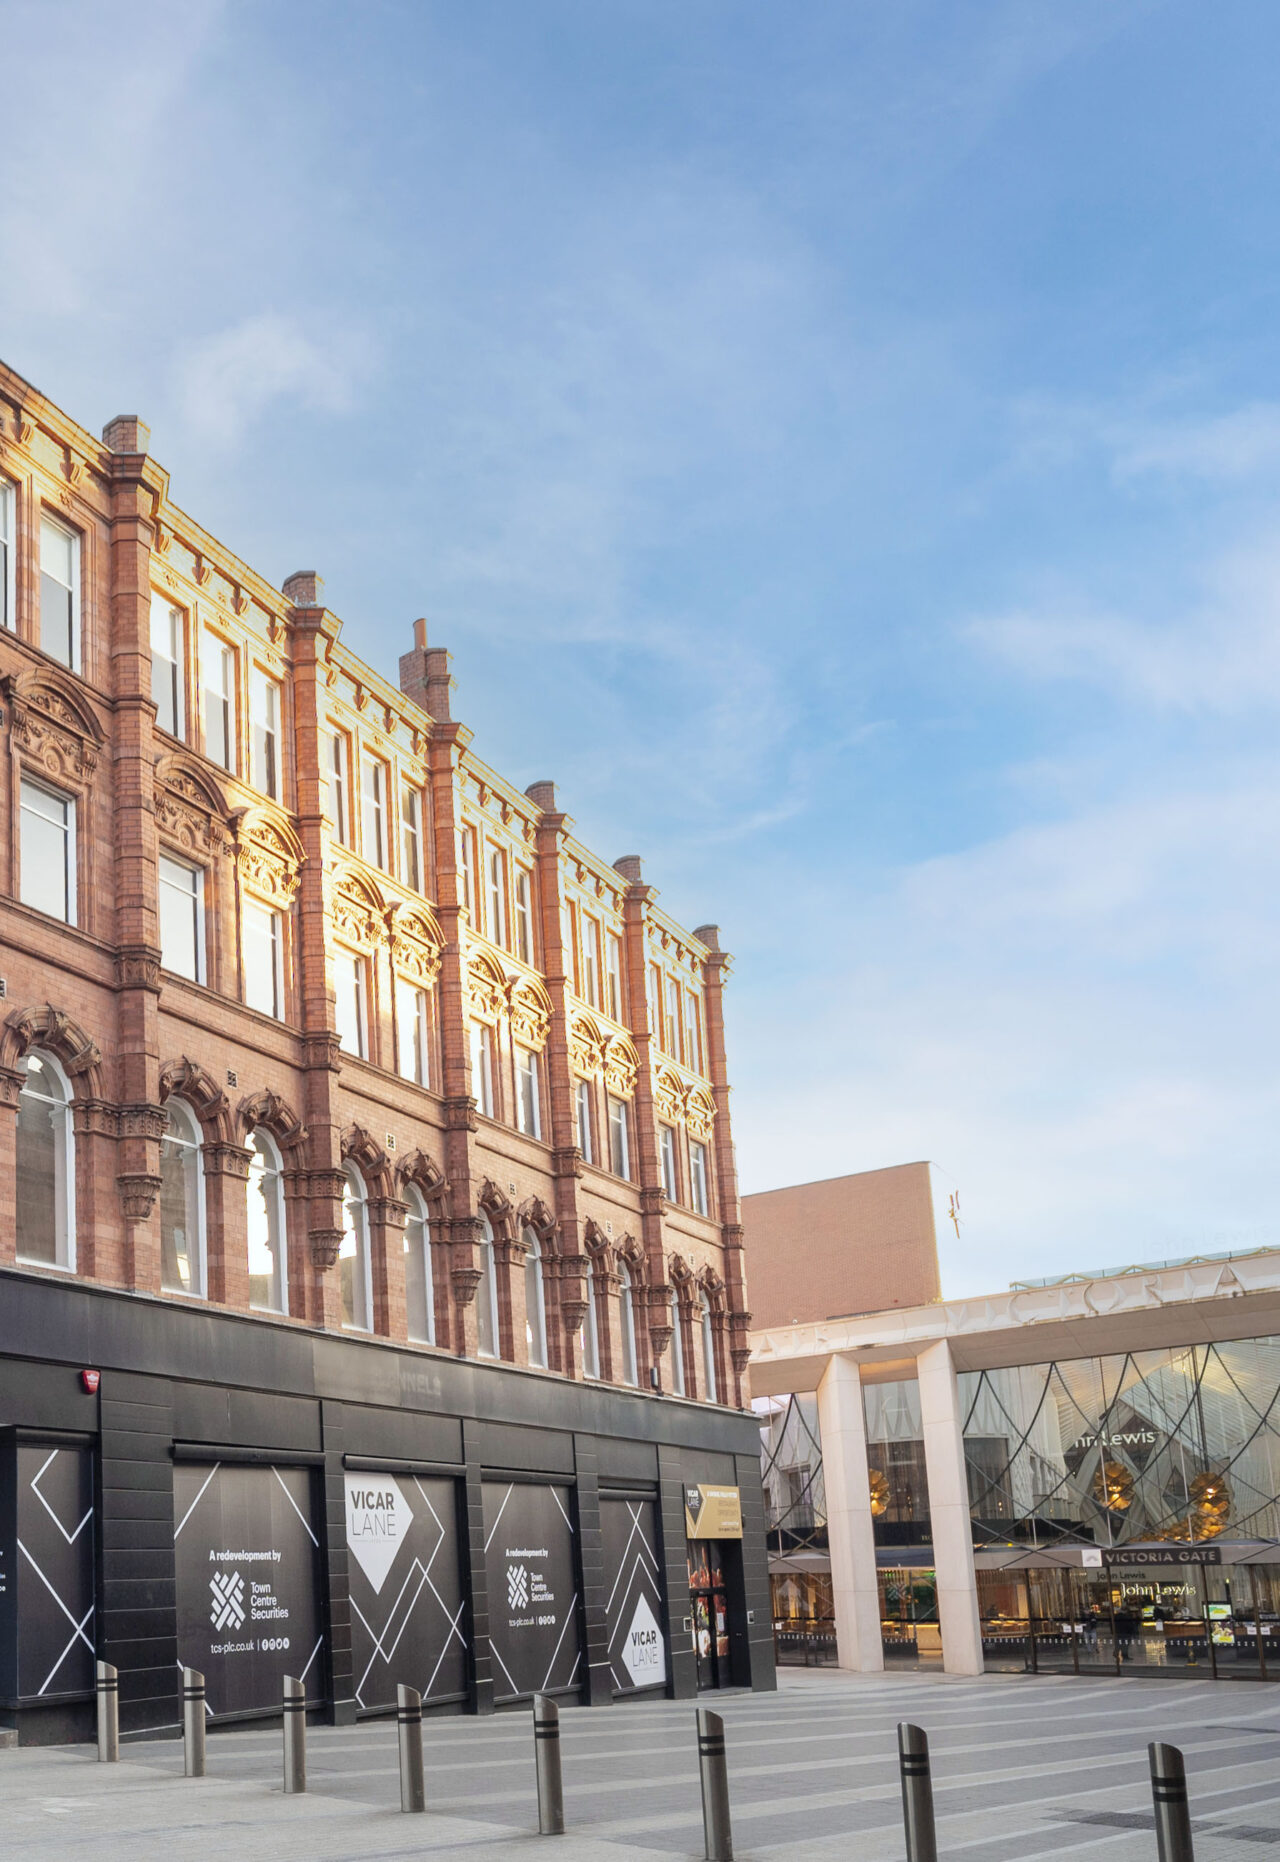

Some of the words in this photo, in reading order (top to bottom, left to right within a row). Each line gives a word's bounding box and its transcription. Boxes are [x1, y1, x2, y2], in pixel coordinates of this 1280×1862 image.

[945, 1263, 1246, 1328] VICTORIA
[1101, 1428, 1156, 1447] Lewis
[351, 1490, 395, 1511] VICAR
[352, 1513, 397, 1537] LANE
[209, 1550, 216, 1561] A
[216, 1549, 272, 1563] redevelopment
[272, 1549, 281, 1562] by
[506, 1548, 510, 1557] A
[510, 1548, 542, 1558] redevelopment
[542, 1548, 549, 1558] by
[1105, 1553, 1174, 1563] VICTORIA
[1178, 1551, 1217, 1562] GATE
[530, 1572, 544, 1582] Town
[1119, 1571, 1146, 1580] Lewis
[250, 1582, 271, 1594] Town
[531, 1583, 548, 1592] Centre
[1121, 1583, 1154, 1599] John
[1155, 1582, 1197, 1596] Lewis
[250, 1595, 278, 1607] Centre
[531, 1592, 555, 1602] Securities
[250, 1607, 289, 1620] Securities
[632, 1630, 657, 1647] VICAR
[211, 1641, 254, 1655] tcs-plc.co.uk
[632, 1646, 659, 1667] LANE
